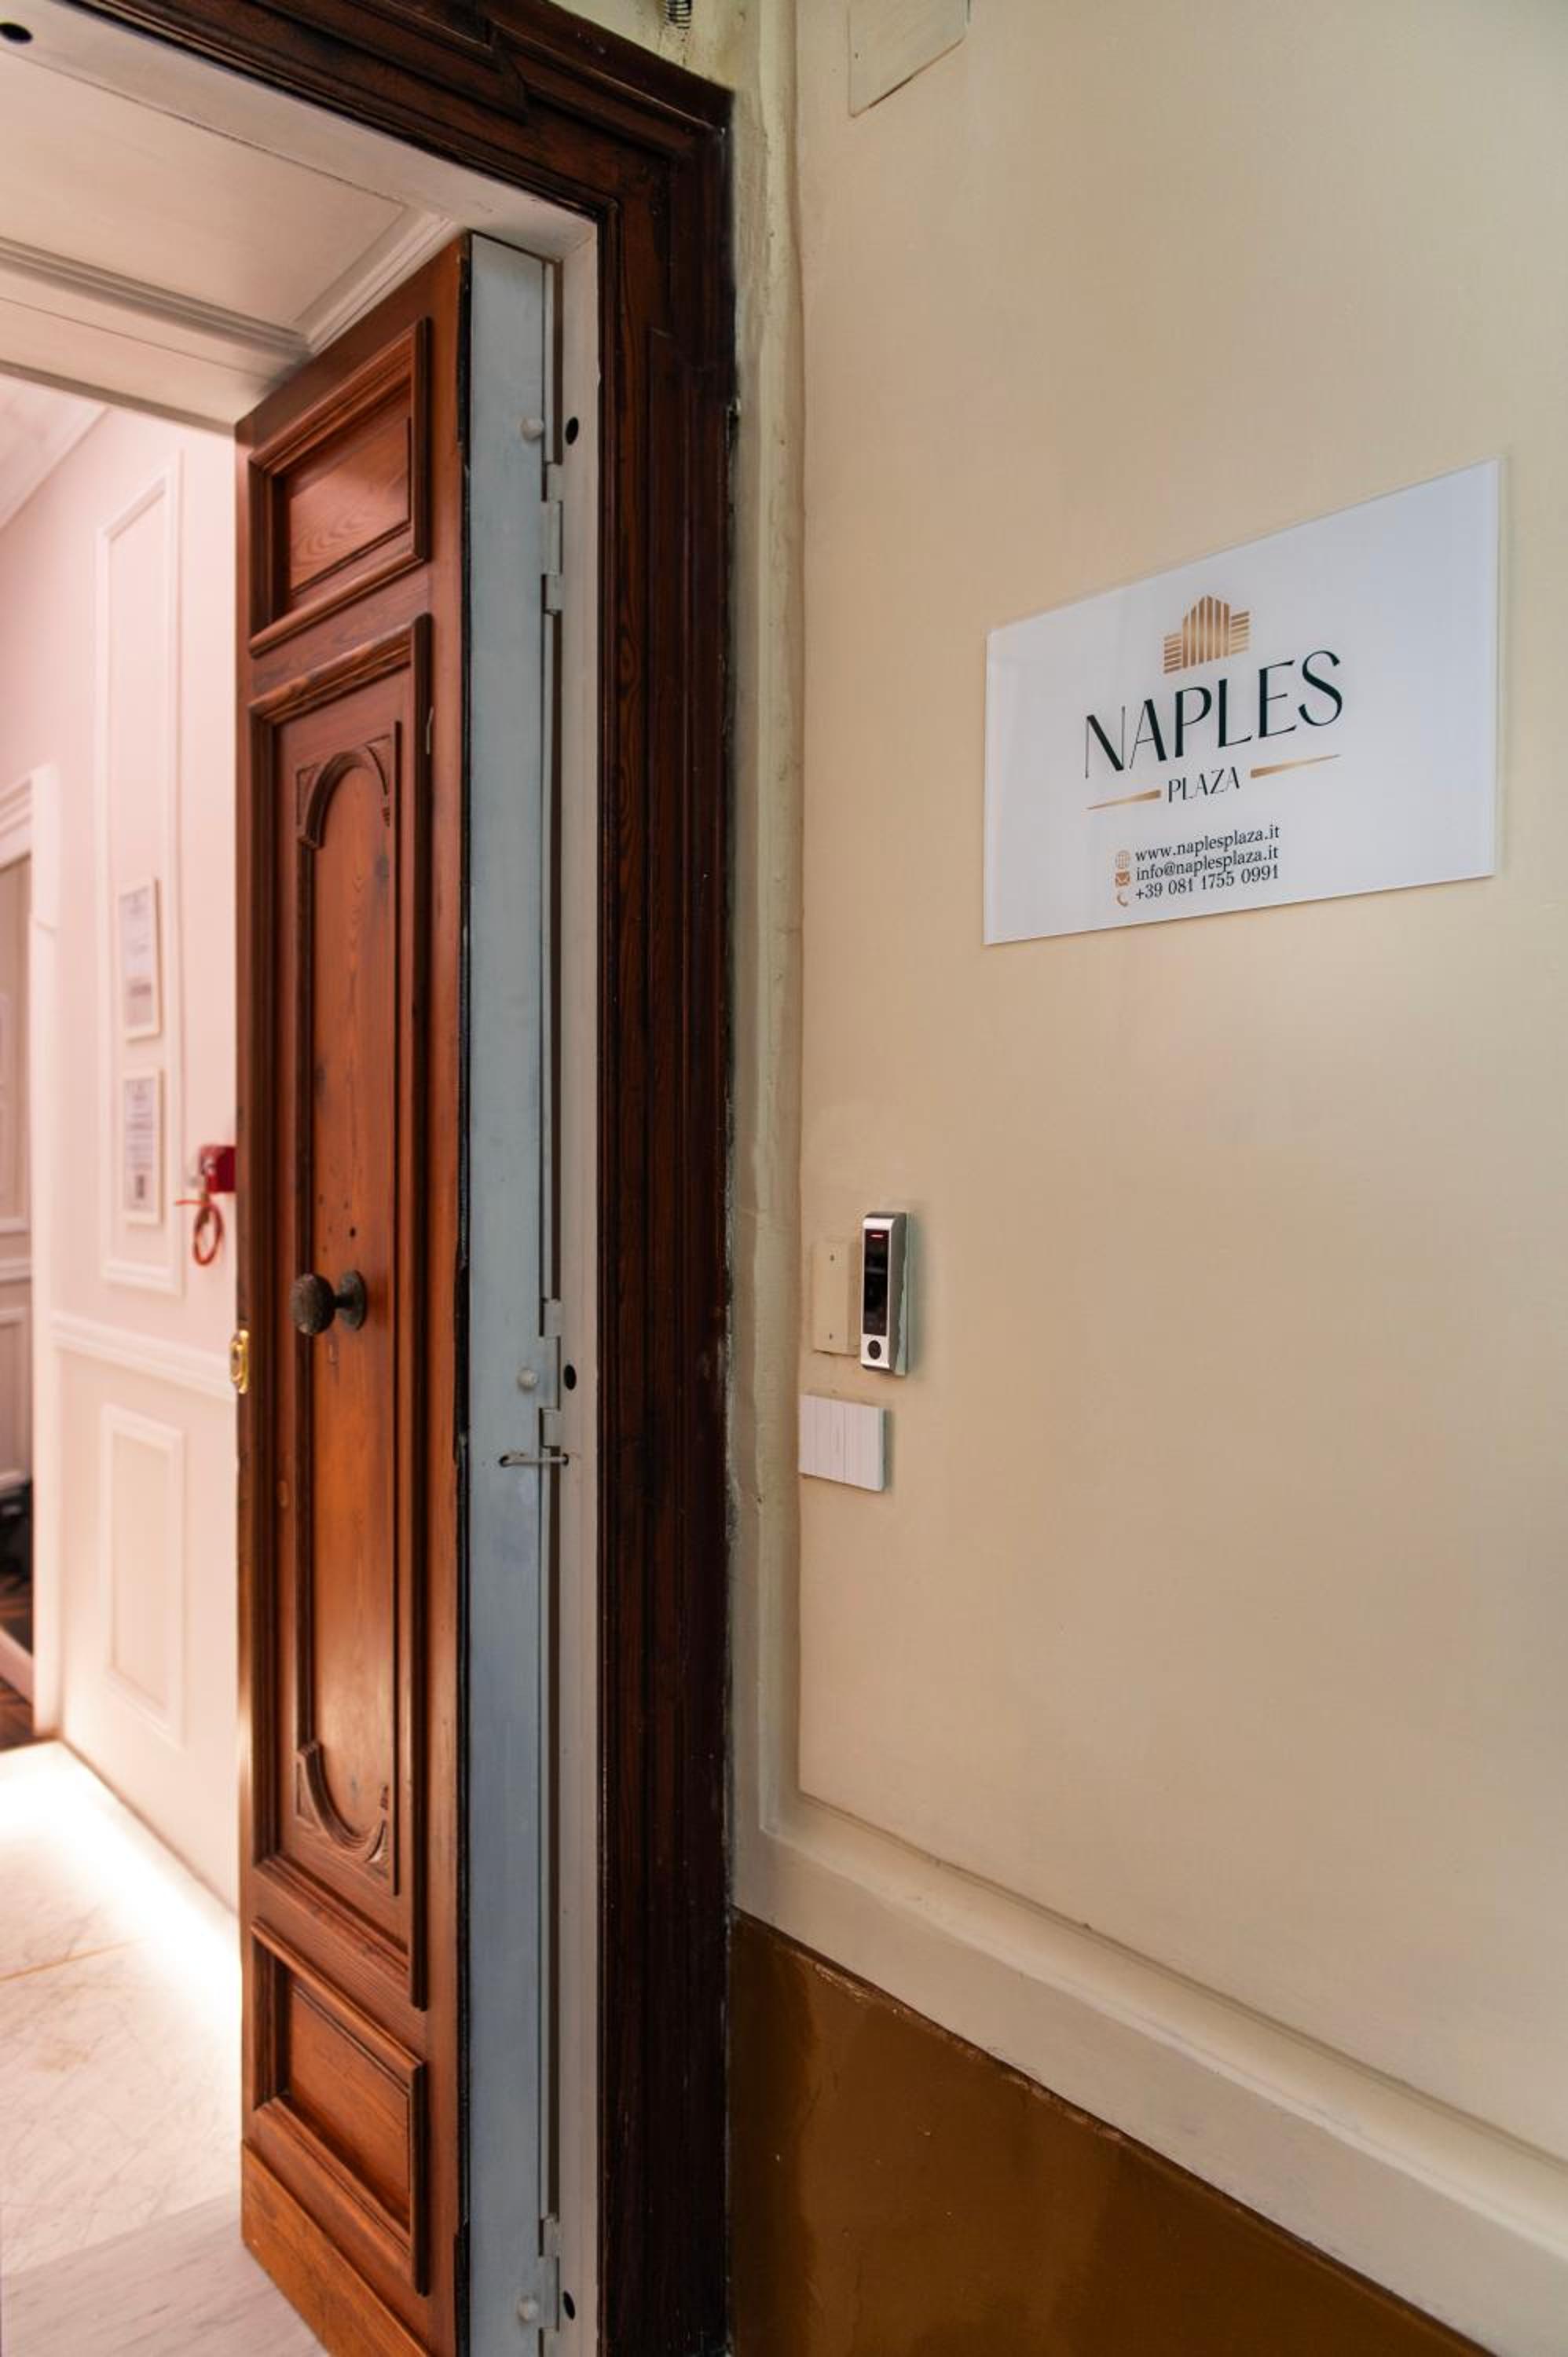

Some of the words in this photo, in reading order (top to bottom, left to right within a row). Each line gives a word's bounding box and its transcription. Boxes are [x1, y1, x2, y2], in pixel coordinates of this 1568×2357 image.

[1084, 650, 1343, 779] NAPLES
[1167, 766, 1240, 803] PLAZA
[1135, 823, 1280, 863] www.naplesplaza.it
[1135, 882, 1163, 900] +39
[1167, 877, 1194, 896] 081
[1201, 870, 1235, 891] 1755
[1240, 863, 1280, 885] 0991
[1136, 845, 1280, 882] info@naplesplaza.it
